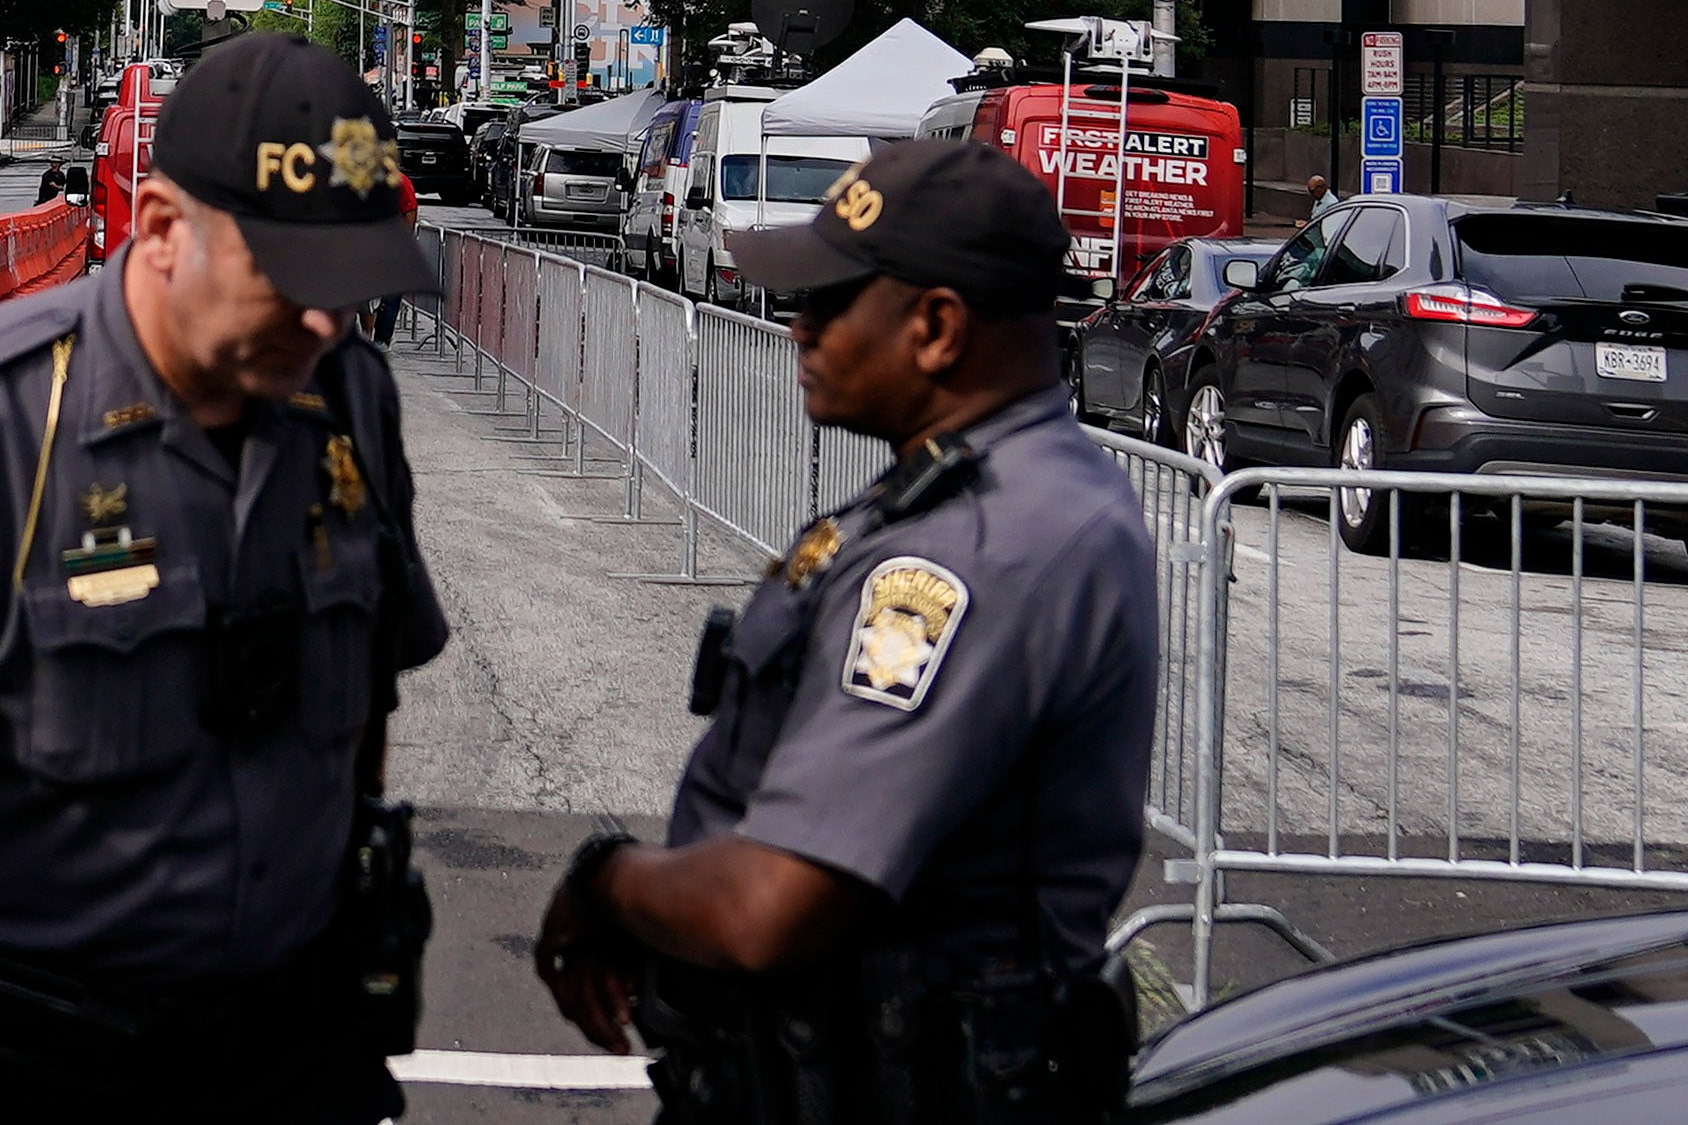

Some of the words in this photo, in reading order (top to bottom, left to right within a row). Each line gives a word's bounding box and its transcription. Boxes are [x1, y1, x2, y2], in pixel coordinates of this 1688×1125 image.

[1043, 126, 1119, 149] FRST
[1125, 133, 1206, 156] ALERT
[256, 141, 316, 193] FC
[1038, 150, 1208, 187] WEATHER
